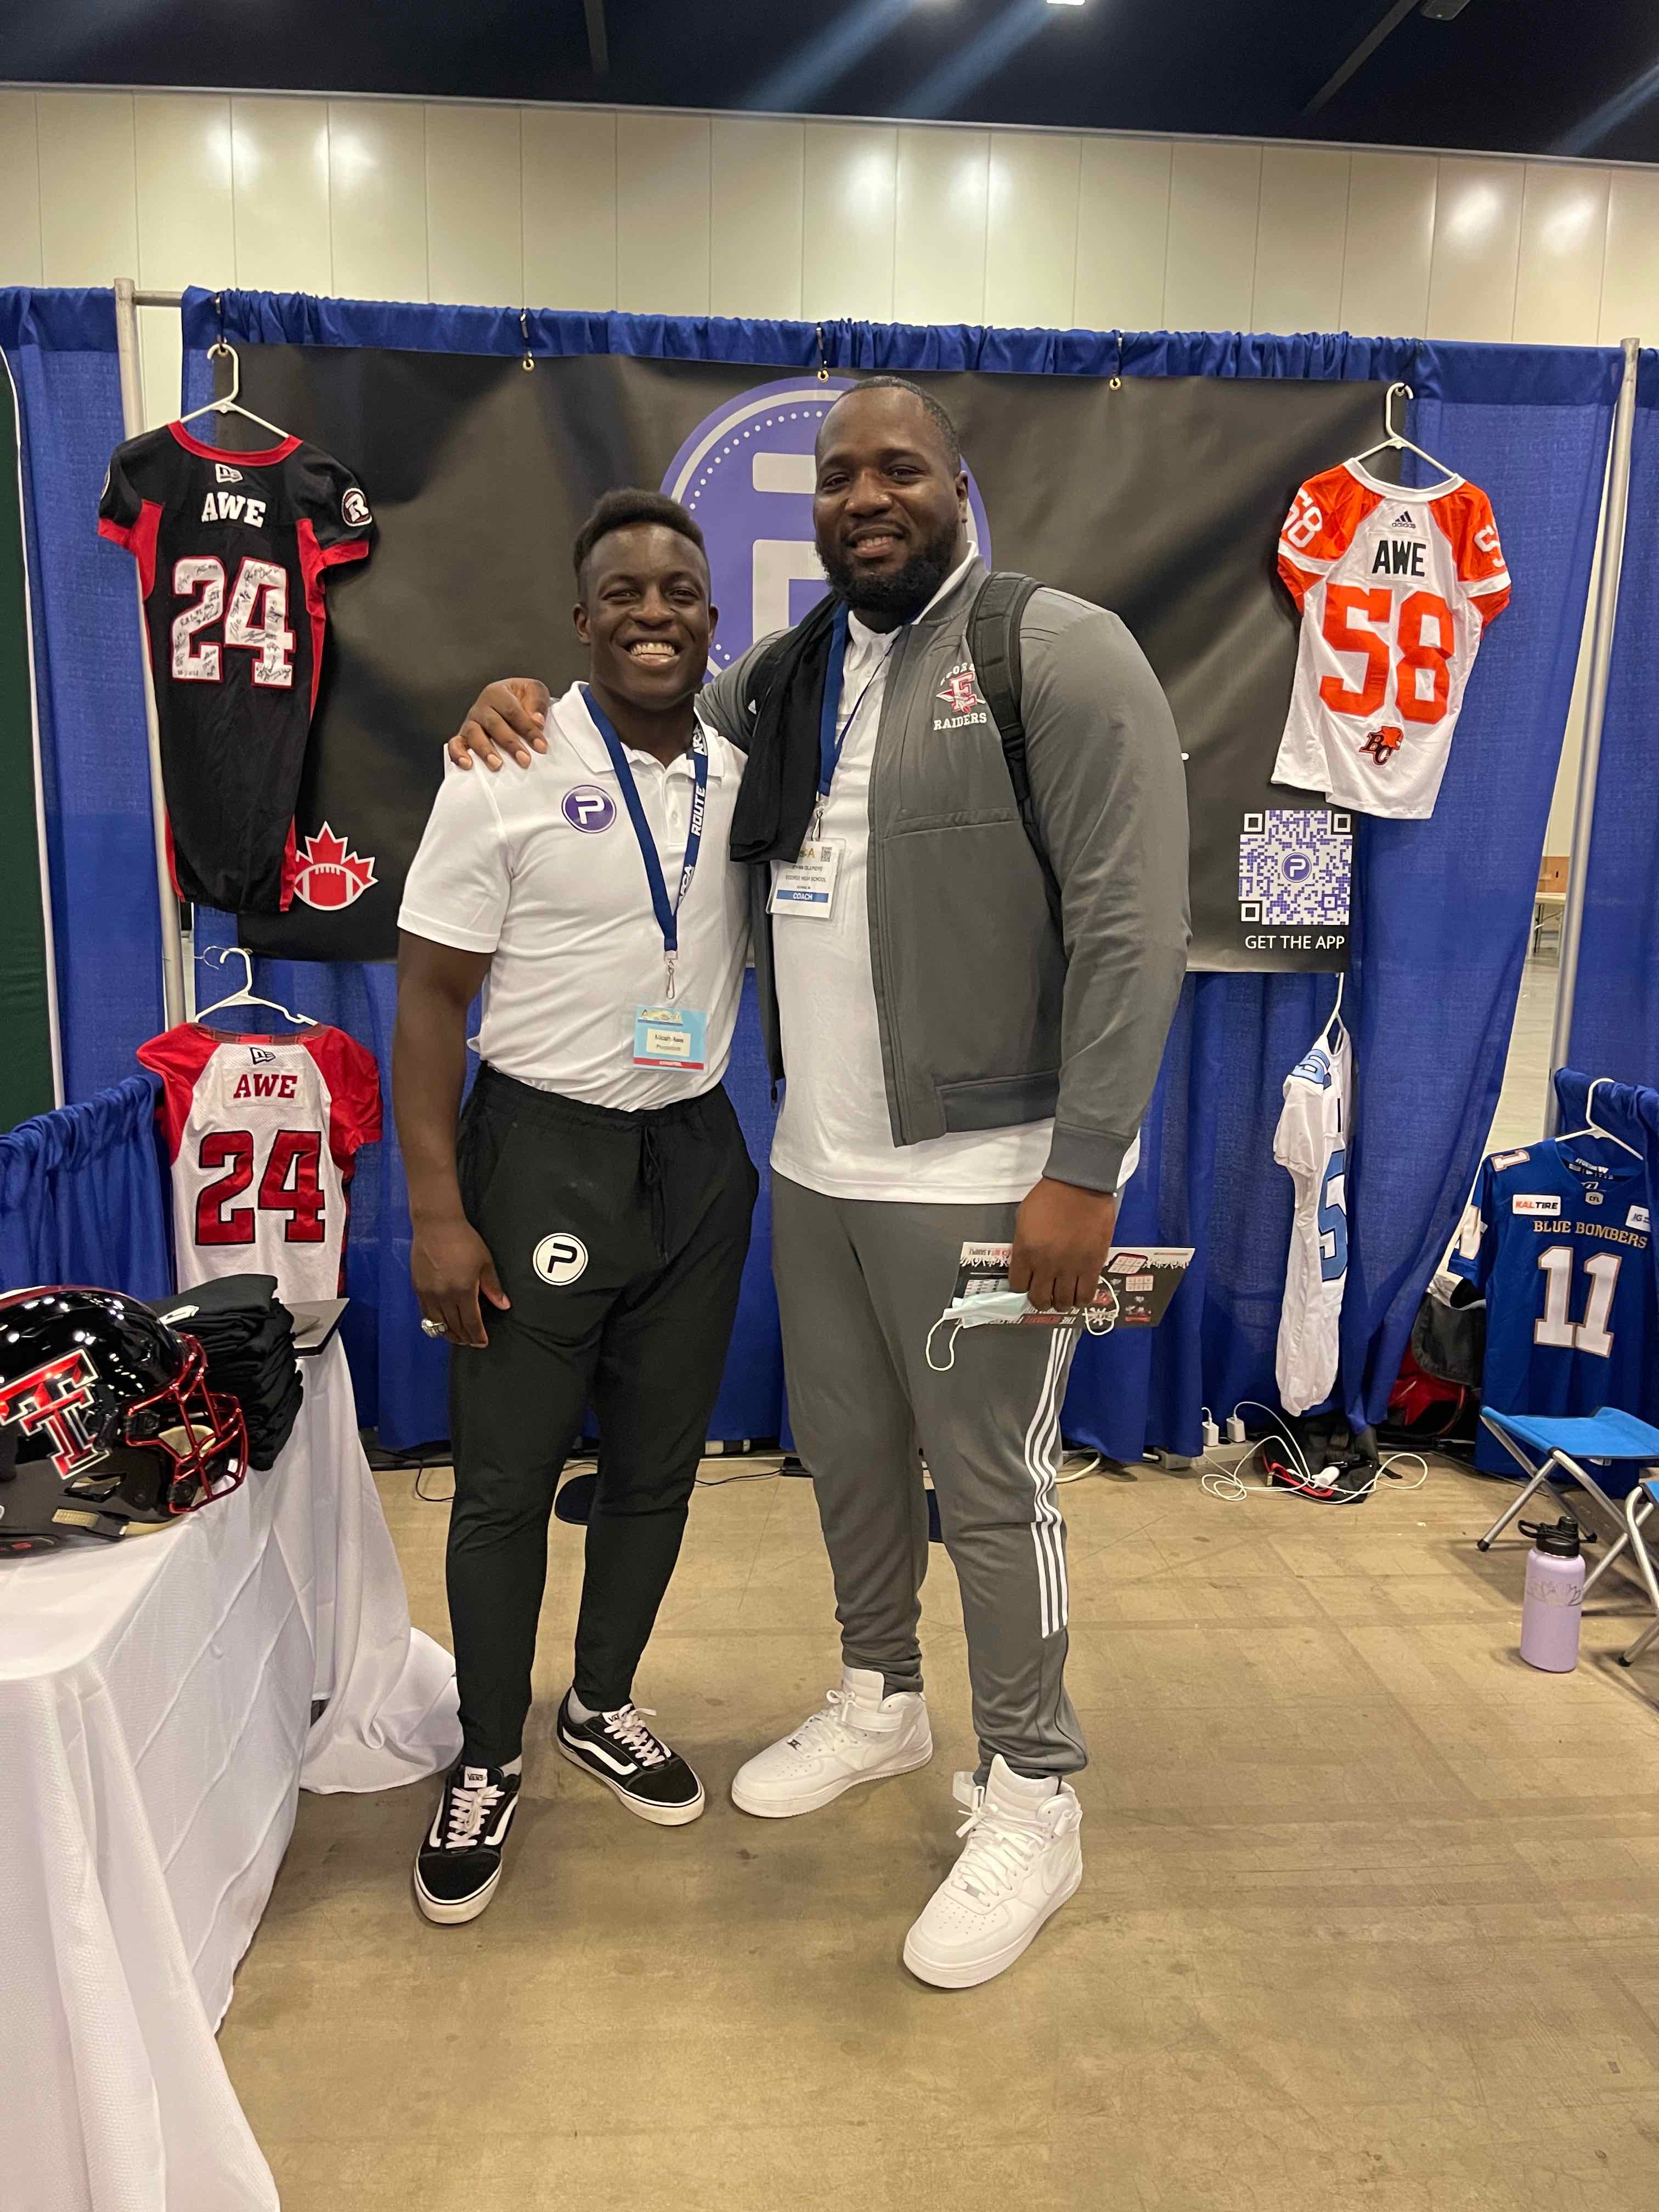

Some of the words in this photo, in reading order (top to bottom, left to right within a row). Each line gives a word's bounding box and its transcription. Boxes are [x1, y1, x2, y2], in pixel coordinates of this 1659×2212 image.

[201, 492, 266, 528] AWE
[1372, 540, 1426, 578] AWE
[172, 555, 296, 689] 24
[1319, 585, 1454, 725] 58
[933, 712, 988, 731] RAIDERS
[1359, 732, 1393, 766] BC
[575, 795, 605, 825] P
[691, 785, 706, 838] ROUTE
[793, 892, 813, 901] COACH
[1245, 935, 1277, 949] GET
[1280, 935, 1312, 950] THE
[1315, 935, 1345, 950] APP
[233, 1074, 297, 1099] AWE
[195, 1130, 325, 1245] 24
[1533, 1220, 1571, 1233] BLUE
[1575, 1221, 1649, 1249] BOMBERS
[547, 1243, 578, 1274] P
[1533, 1246, 1623, 1359] 11
[1059, 1316, 1076, 1325] THE
